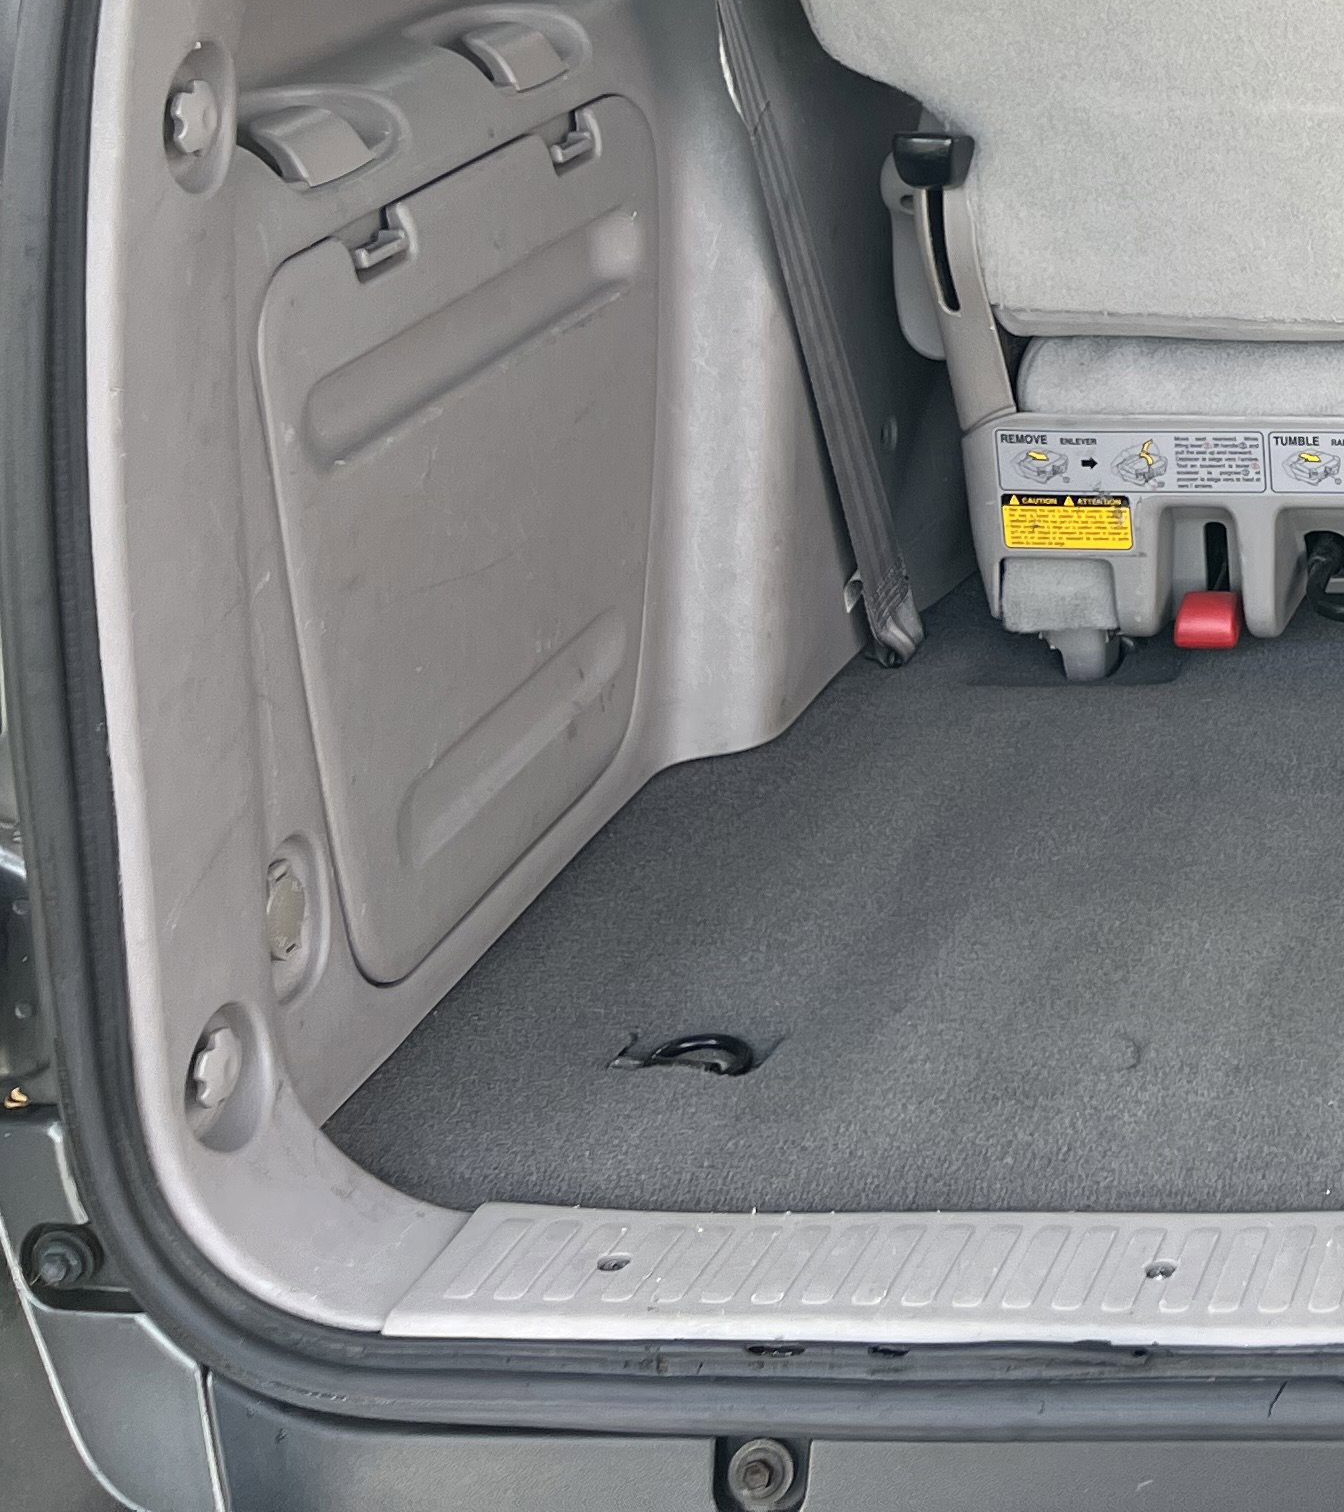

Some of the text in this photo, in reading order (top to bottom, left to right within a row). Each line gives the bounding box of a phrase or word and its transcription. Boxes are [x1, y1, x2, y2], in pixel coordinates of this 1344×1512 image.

[1000, 433, 1048, 445] REMOVE
[1060, 437, 1097, 446] ENLEVER
[1273, 436, 1320, 447] TUMBLE
[1022, 497, 1058, 505] CAUTION
[1077, 497, 1122, 506] ATTENTION
